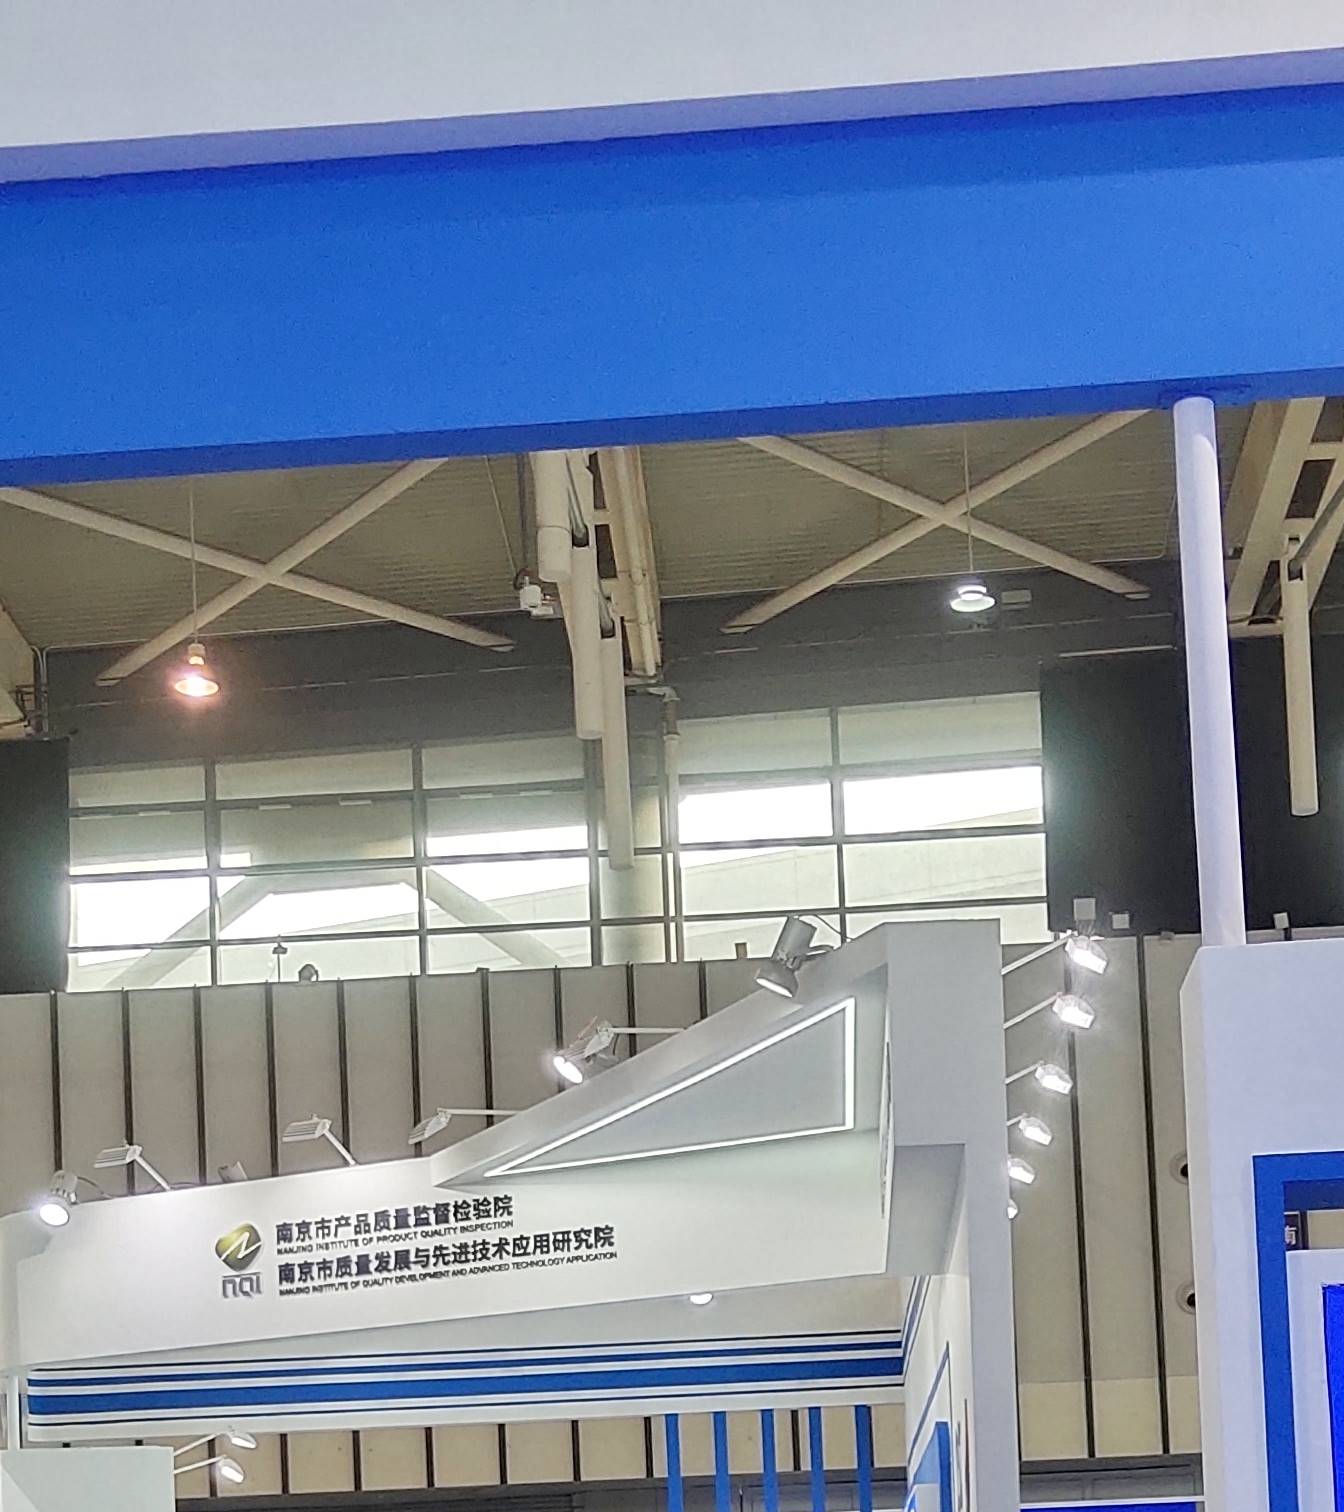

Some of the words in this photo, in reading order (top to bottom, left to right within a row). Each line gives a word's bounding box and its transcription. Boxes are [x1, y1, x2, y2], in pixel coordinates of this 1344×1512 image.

[276, 1194, 514, 1245] 南京市产品质量监督检验院
[315, 1238, 359, 1252] INSTITUTE
[362, 1236, 374, 1246] OF
[376, 1230, 418, 1244] PRODUCT
[420, 1226, 458, 1239] QUALITY
[459, 1220, 514, 1234] INSPECTION
[277, 1225, 616, 1285] 南京市质量发展与先进技术应用研究院
[362, 1276, 394, 1288] QUALITY
[451, 1267, 467, 1277] AND
[468, 1262, 510, 1275] ADVANCED
[511, 1257, 565, 1271] TECHNOLOGY
[566, 1250, 617, 1265] APPLICATION
